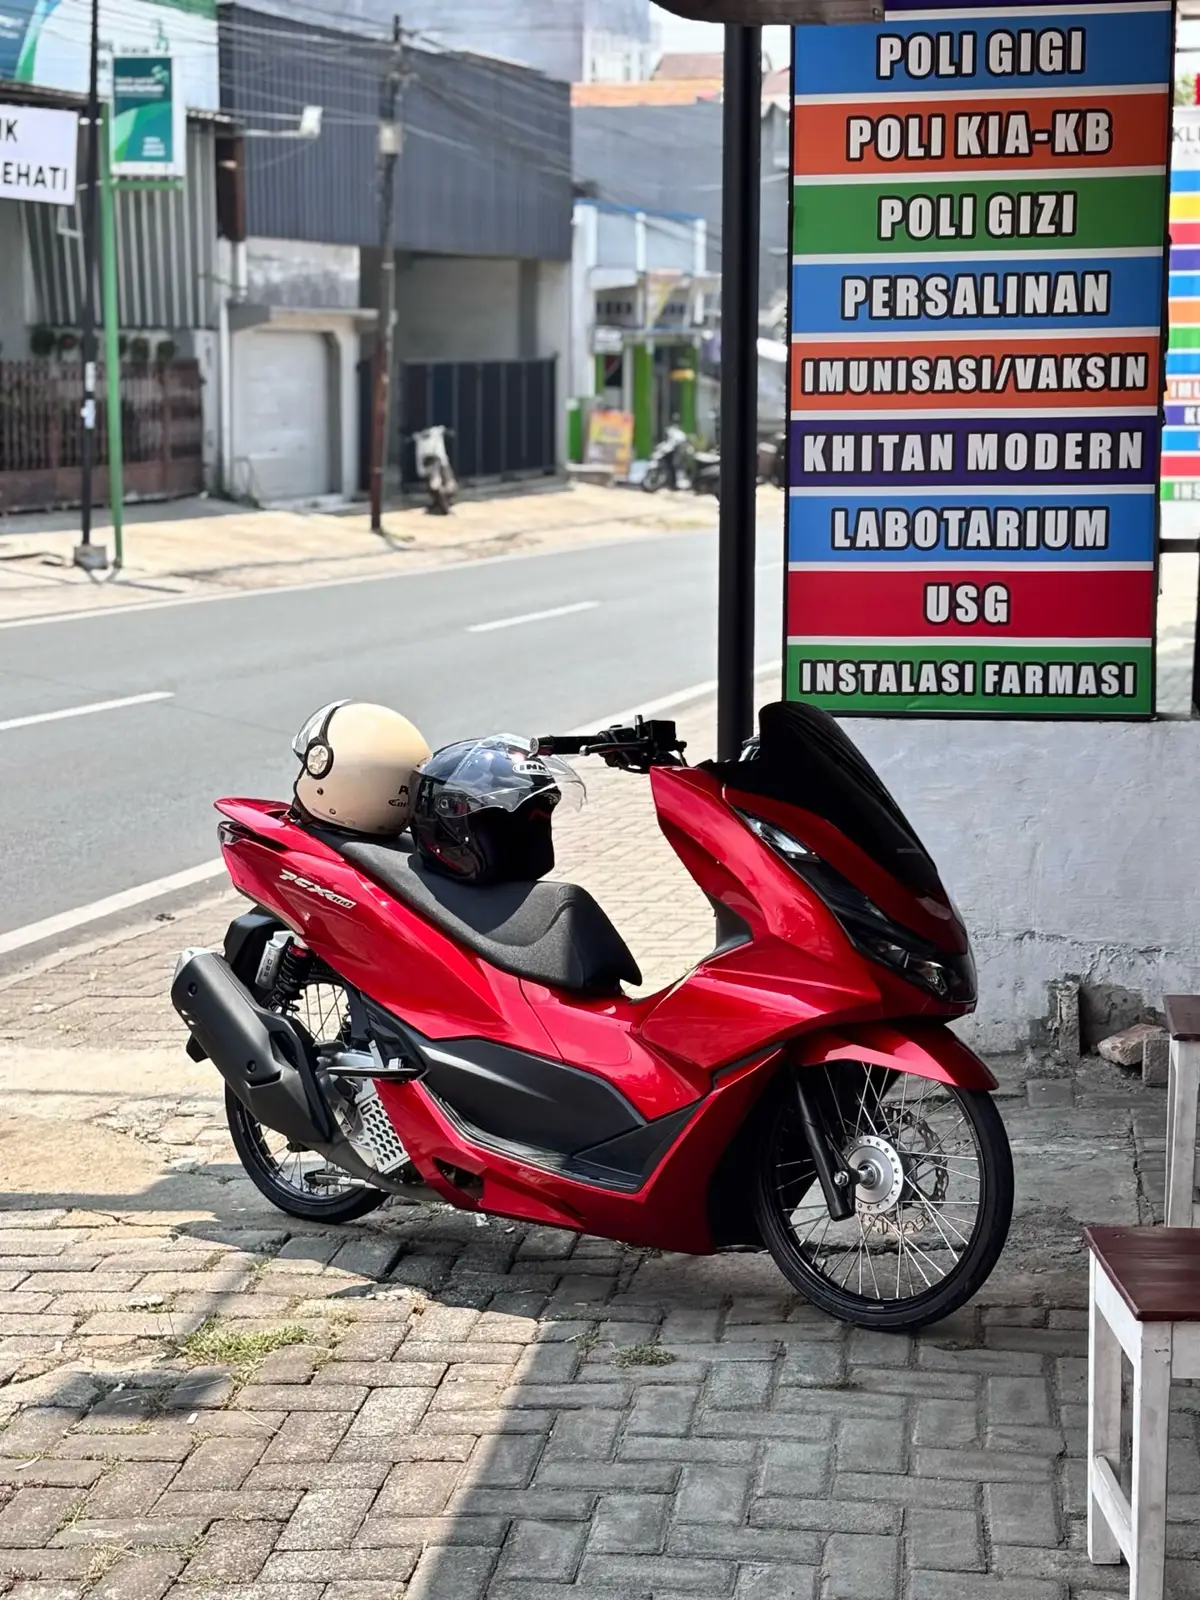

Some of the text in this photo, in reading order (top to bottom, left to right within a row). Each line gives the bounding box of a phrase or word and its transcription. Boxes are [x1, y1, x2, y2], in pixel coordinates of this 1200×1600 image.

[878, 30, 1083, 78] POLI GIGI
[848, 111, 1110, 160] POLI KIA-KB
[879, 193, 1075, 239] POLI GIZI
[843, 273, 1109, 319] PERSALINAN
[803, 355, 1147, 393] IMUNISASI/VAKSIN
[802, 431, 1143, 473] KHITAN MODERN
[832, 508, 1107, 549] LABOTARIUM
[925, 584, 1010, 624] USG
[801, 661, 1135, 696] INSTALASI FARMASI
